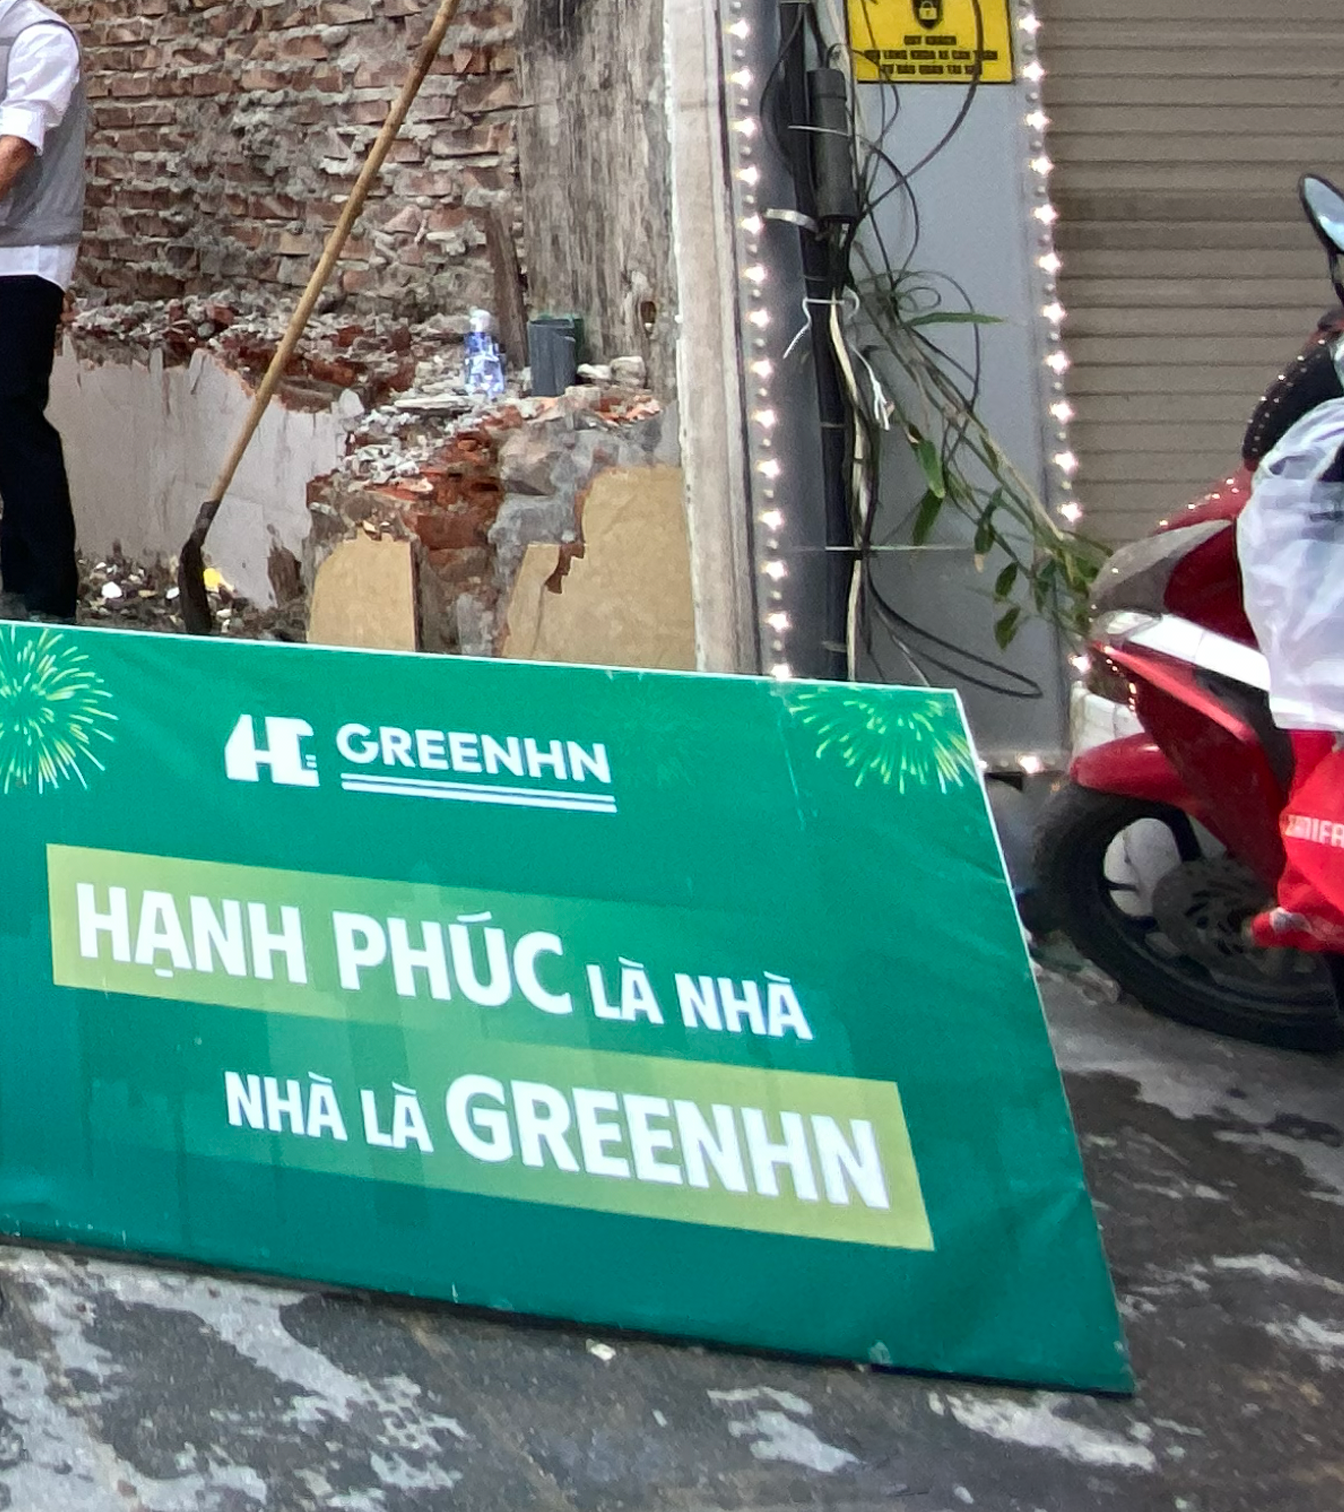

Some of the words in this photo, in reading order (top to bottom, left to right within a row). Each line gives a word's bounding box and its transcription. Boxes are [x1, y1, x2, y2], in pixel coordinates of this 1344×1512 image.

[335, 722, 612, 784] GREENHN
[76, 882, 308, 984] HẠNH
[332, 909, 572, 1015] PHÚC
[587, 956, 663, 1026] LÀ
[675, 970, 813, 1041] NHÀ
[224, 1070, 348, 1142] NHÀ
[360, 1081, 434, 1153] LÀ
[445, 1072, 891, 1210] GREENHN
